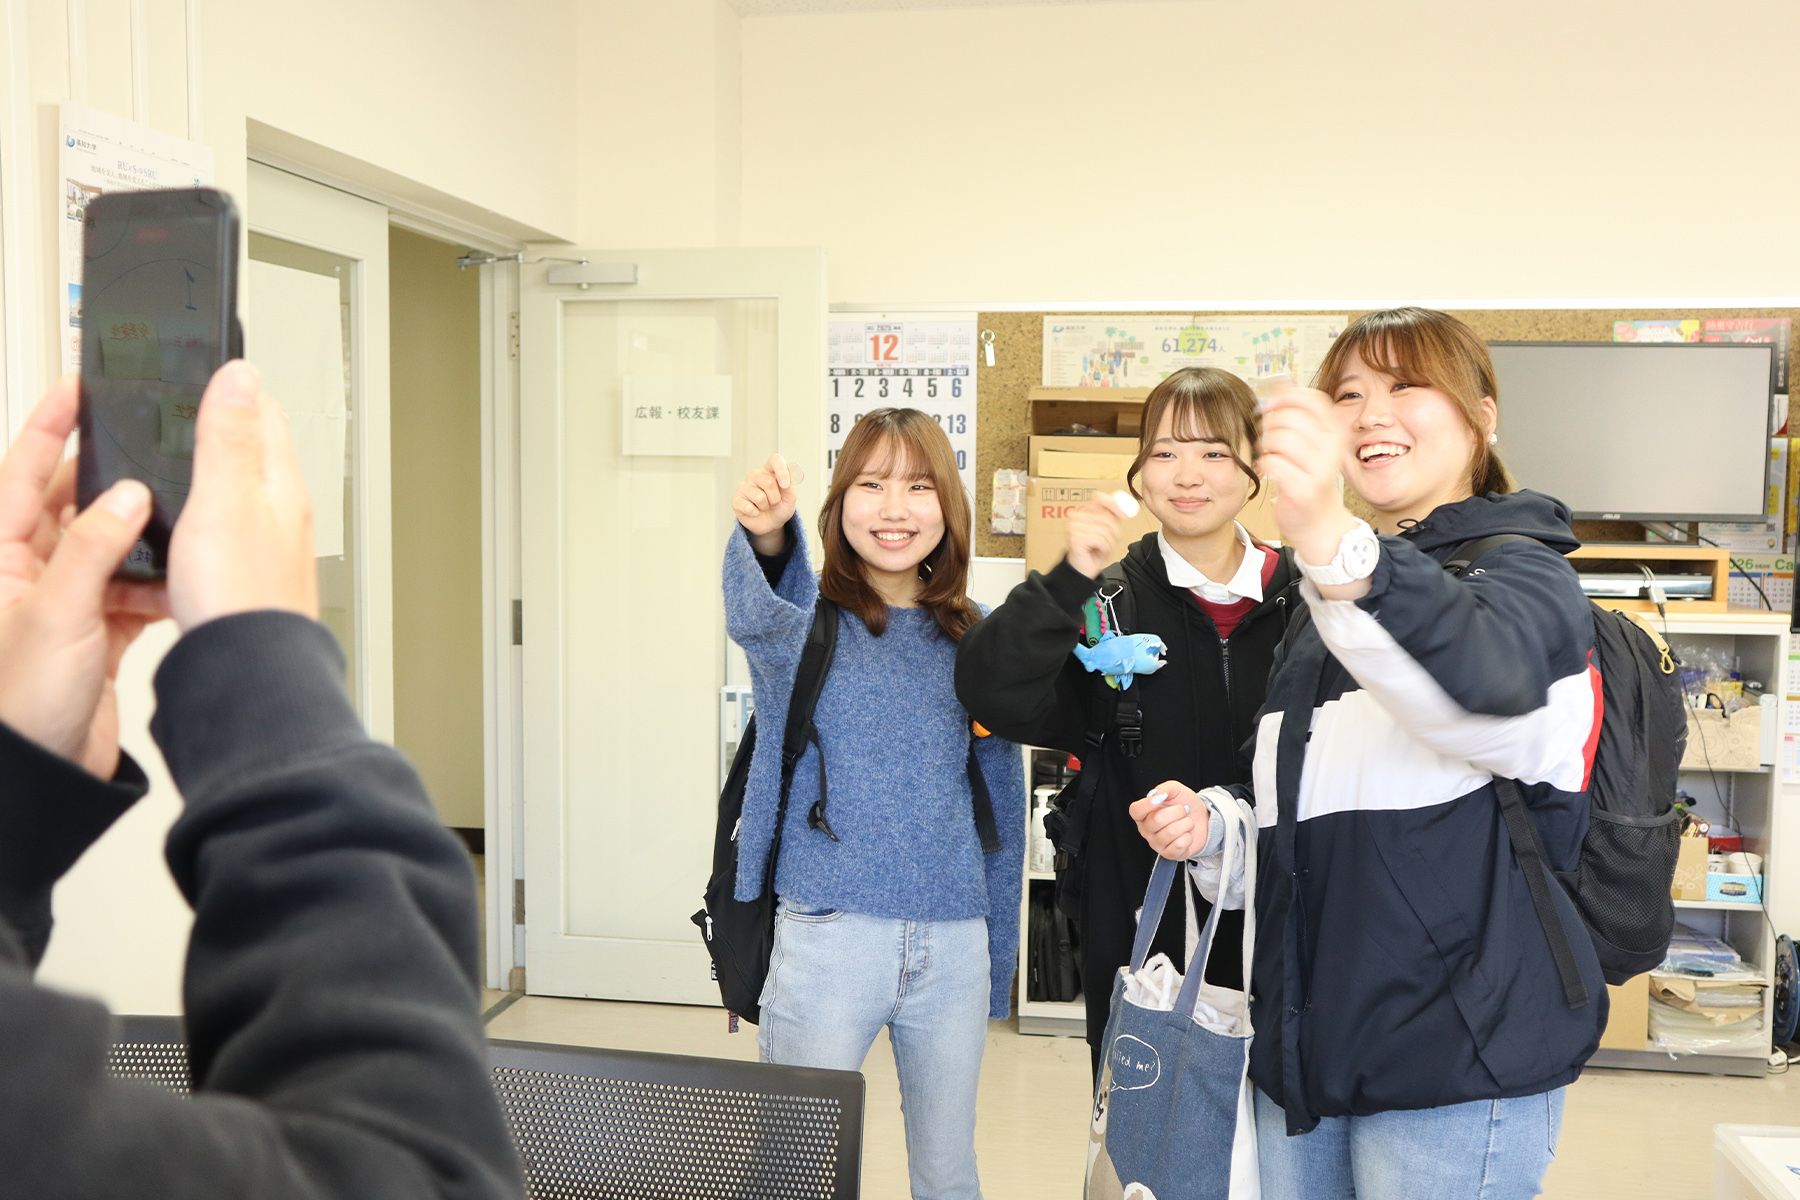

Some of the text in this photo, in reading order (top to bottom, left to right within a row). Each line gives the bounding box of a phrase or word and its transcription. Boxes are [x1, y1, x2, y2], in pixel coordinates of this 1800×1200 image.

[870, 334, 899, 361] 12
[832, 378, 962, 398] 1 2 3 4 5 6
[634, 405, 720, 420] 広報・校友課
[830, 413, 840, 434] 8
[947, 414, 967, 434] 13
